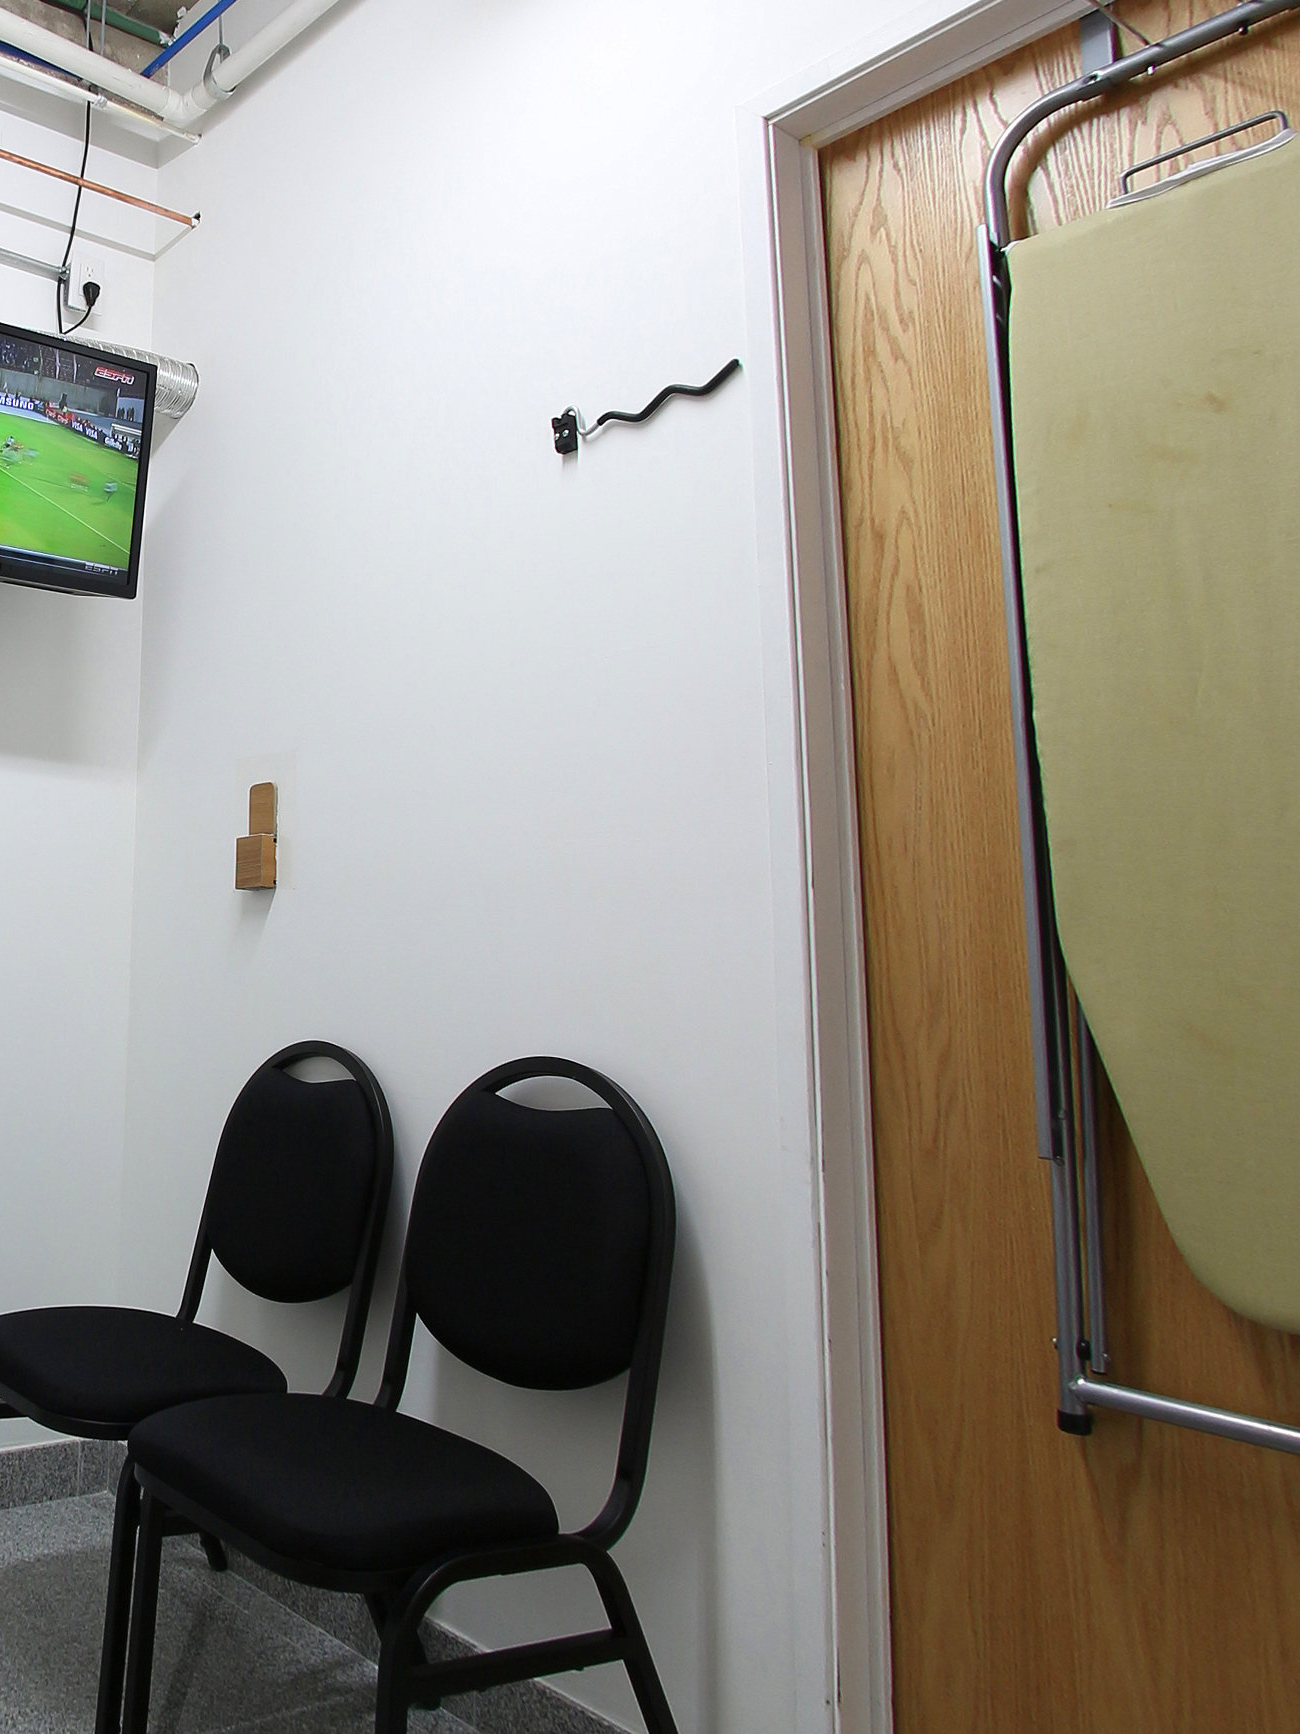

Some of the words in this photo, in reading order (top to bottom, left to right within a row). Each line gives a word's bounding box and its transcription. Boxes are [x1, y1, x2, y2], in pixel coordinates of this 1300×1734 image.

[94, 365, 135, 385] ESPN
[71, 420, 83, 432] VISA
[85, 426, 98, 440] VISA
